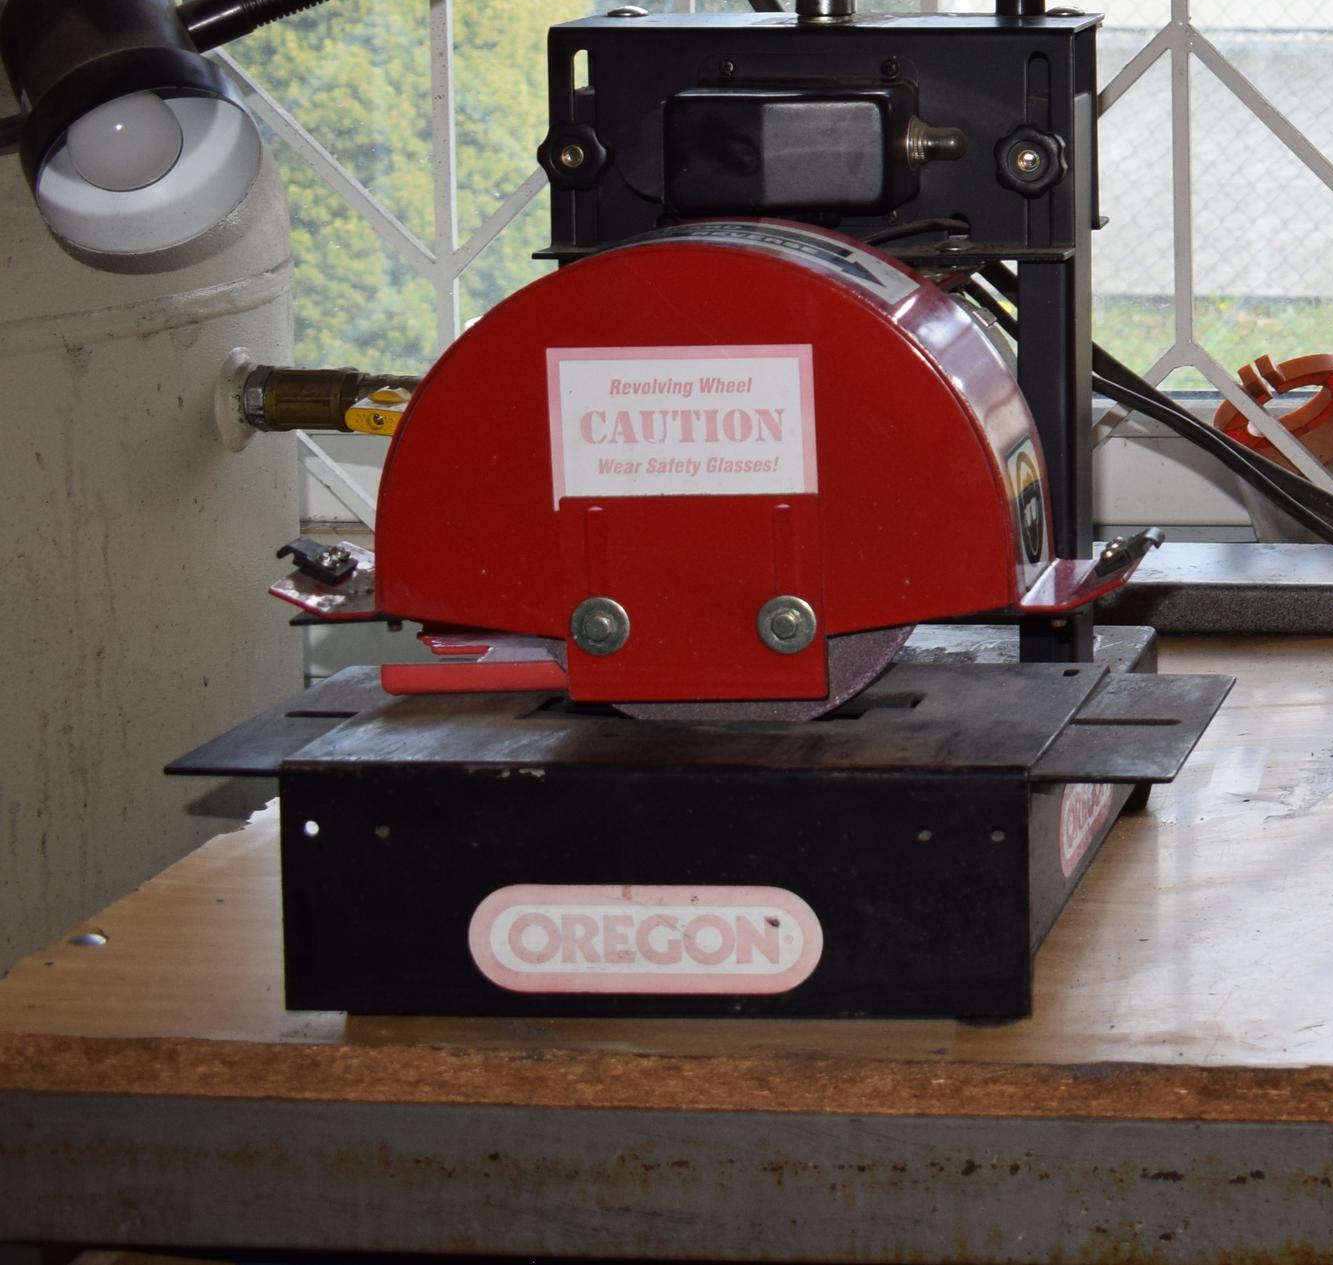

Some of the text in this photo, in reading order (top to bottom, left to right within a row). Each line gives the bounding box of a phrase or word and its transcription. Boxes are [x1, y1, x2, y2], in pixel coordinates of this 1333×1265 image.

[691, 230, 819, 255] REVERSE
[609, 377, 753, 397] Revolving Wheel
[580, 408, 785, 445] CAUTION
[598, 456, 780, 477] Wear Safety Glasses!
[508, 911, 781, 965] OREGON
